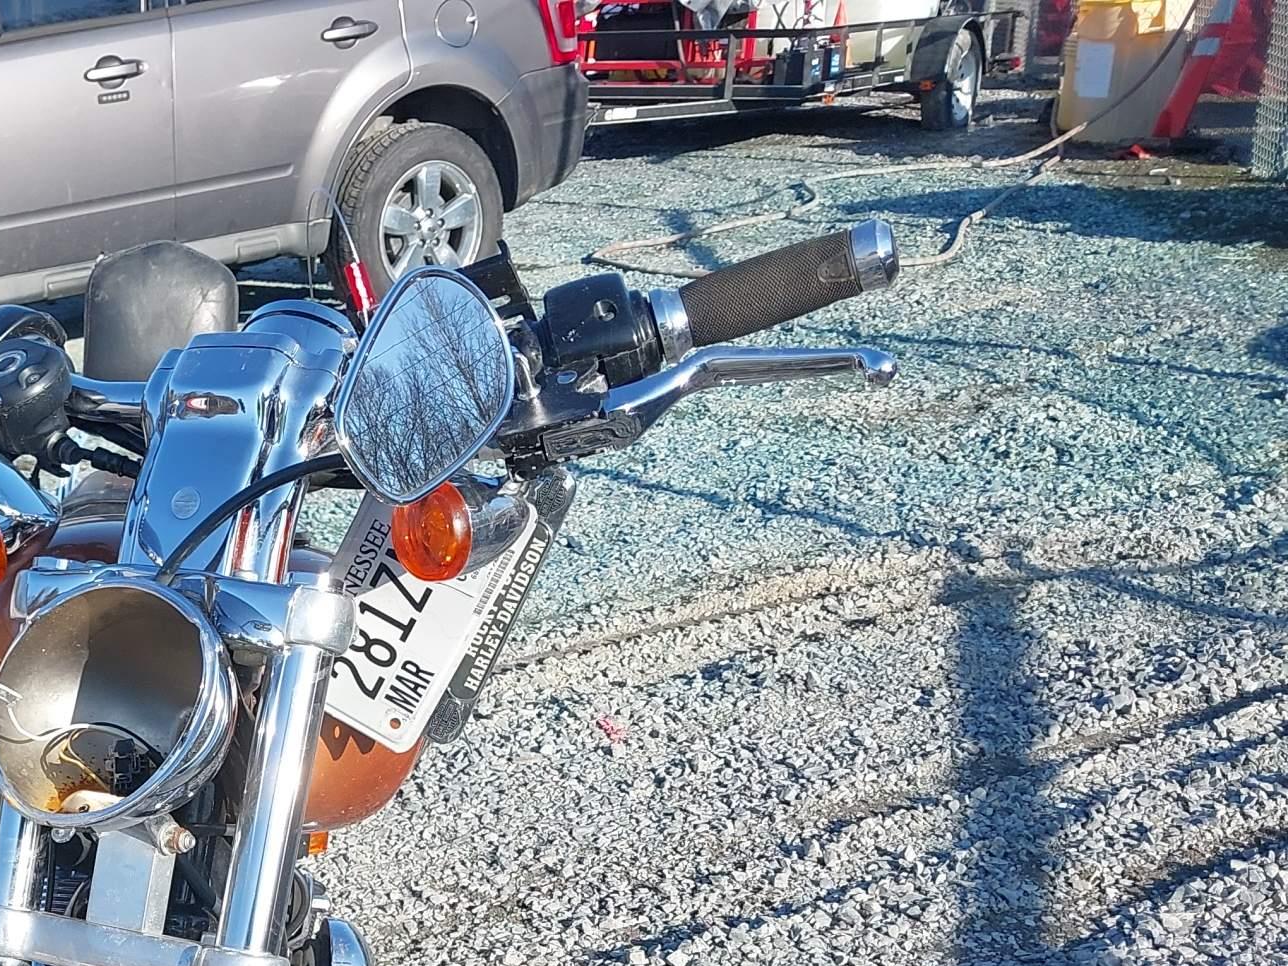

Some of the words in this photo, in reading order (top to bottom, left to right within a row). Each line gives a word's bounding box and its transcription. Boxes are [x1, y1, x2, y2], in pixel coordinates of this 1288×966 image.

[344, 519, 391, 597] NESSEE
[464, 537, 547, 692] HARLEY-DAVIDSON
[331, 548, 433, 700] 281Z
[384, 659, 435, 715] MAR
